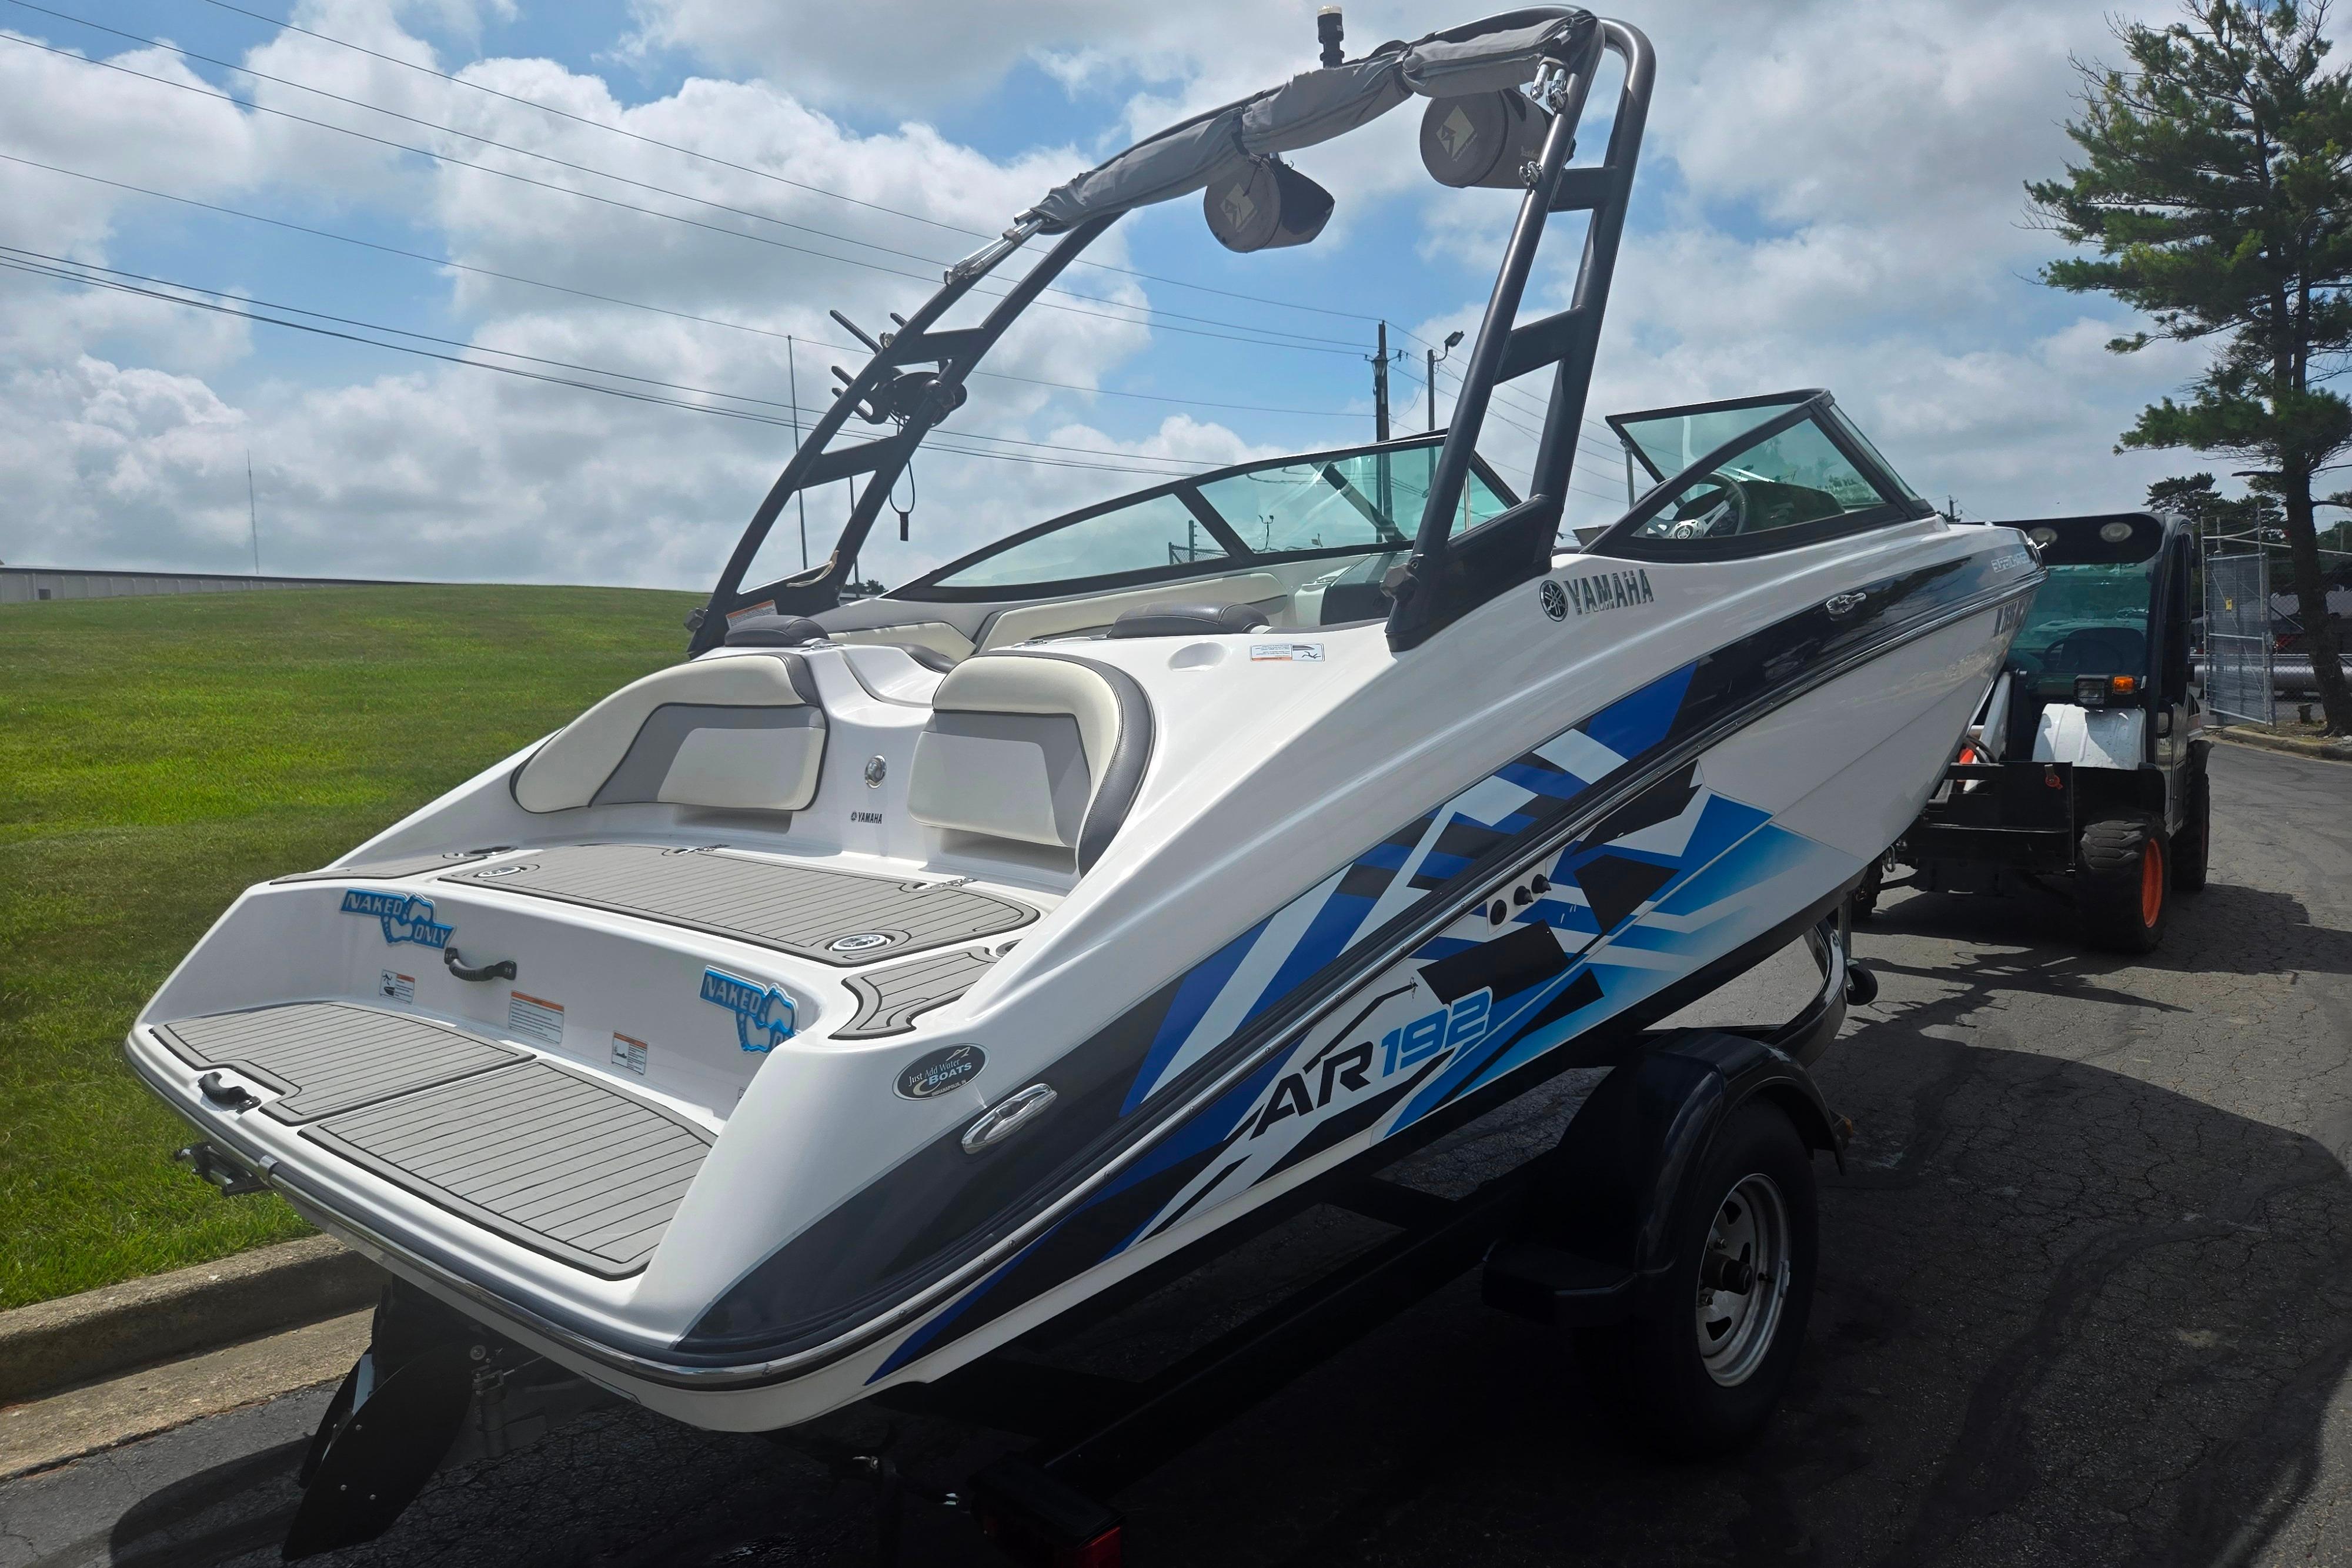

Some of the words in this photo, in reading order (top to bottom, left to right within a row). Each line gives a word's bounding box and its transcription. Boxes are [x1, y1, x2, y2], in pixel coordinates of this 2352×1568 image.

[1563, 569, 1654, 616] YAMAHA
[858, 812, 883, 824] YAMAHA
[345, 893, 403, 915] NAKED
[414, 922, 448, 945] ONLY
[706, 975, 763, 1015] NAKED
[908, 1072, 923, 1086] Just
[925, 1065, 938, 1078] Add
[939, 1059, 960, 1071] Water
[928, 1062, 972, 1085] BOATS
